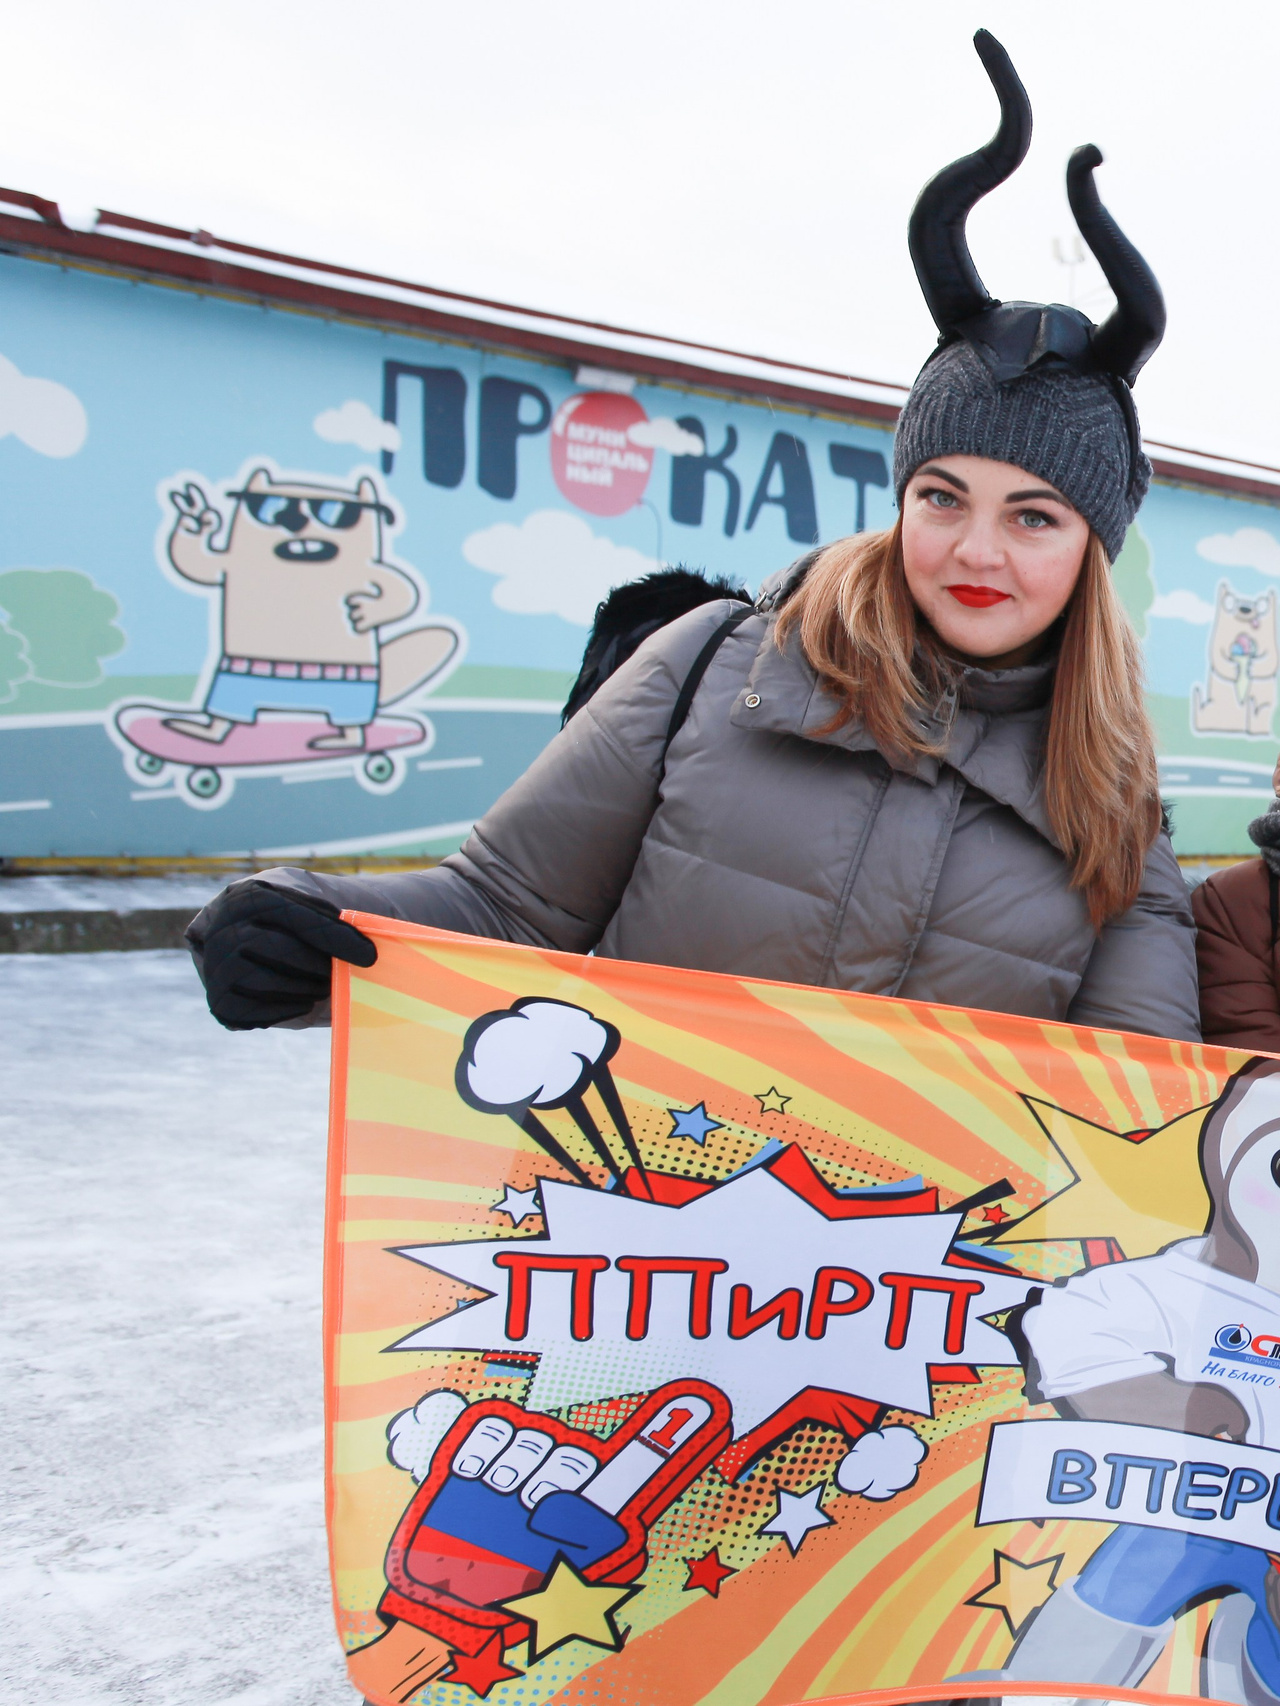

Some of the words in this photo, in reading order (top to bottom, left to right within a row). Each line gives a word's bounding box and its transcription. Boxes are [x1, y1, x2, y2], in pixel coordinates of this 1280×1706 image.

[567, 421, 626, 449] МУНИ
[566, 442, 650, 473] ЦИПАЛЬ
[565, 461, 614, 488] НЫЙ
[648, 1408, 694, 1450] 1
